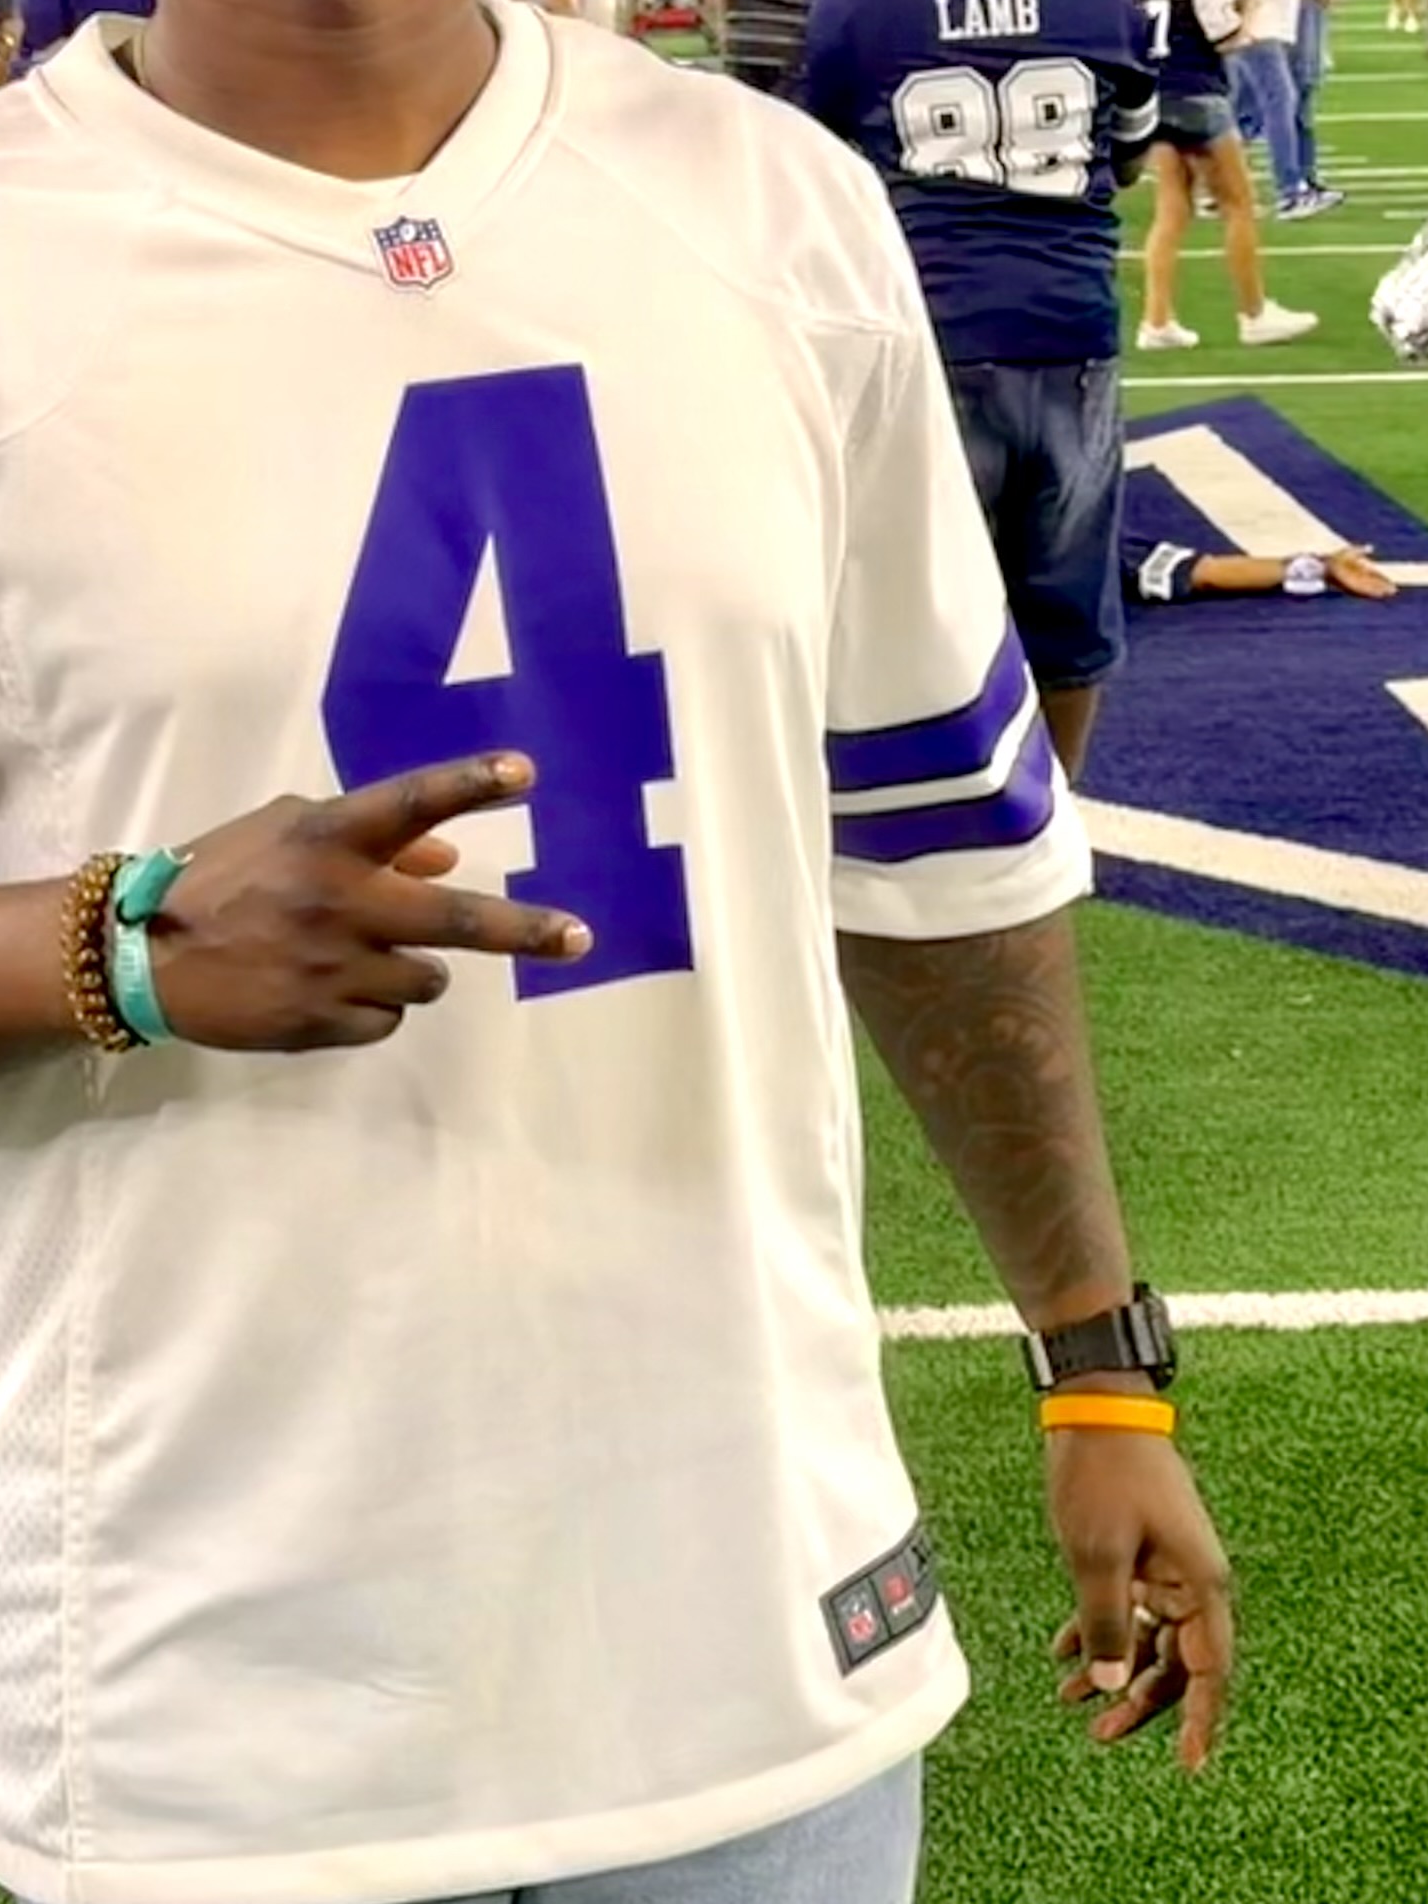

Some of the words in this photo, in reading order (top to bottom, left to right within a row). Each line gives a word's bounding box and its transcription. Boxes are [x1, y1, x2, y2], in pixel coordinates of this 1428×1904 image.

[893, 57, 1097, 196] 88
[389, 242, 448, 280] NFL
[322, 362, 694, 1001] 4
